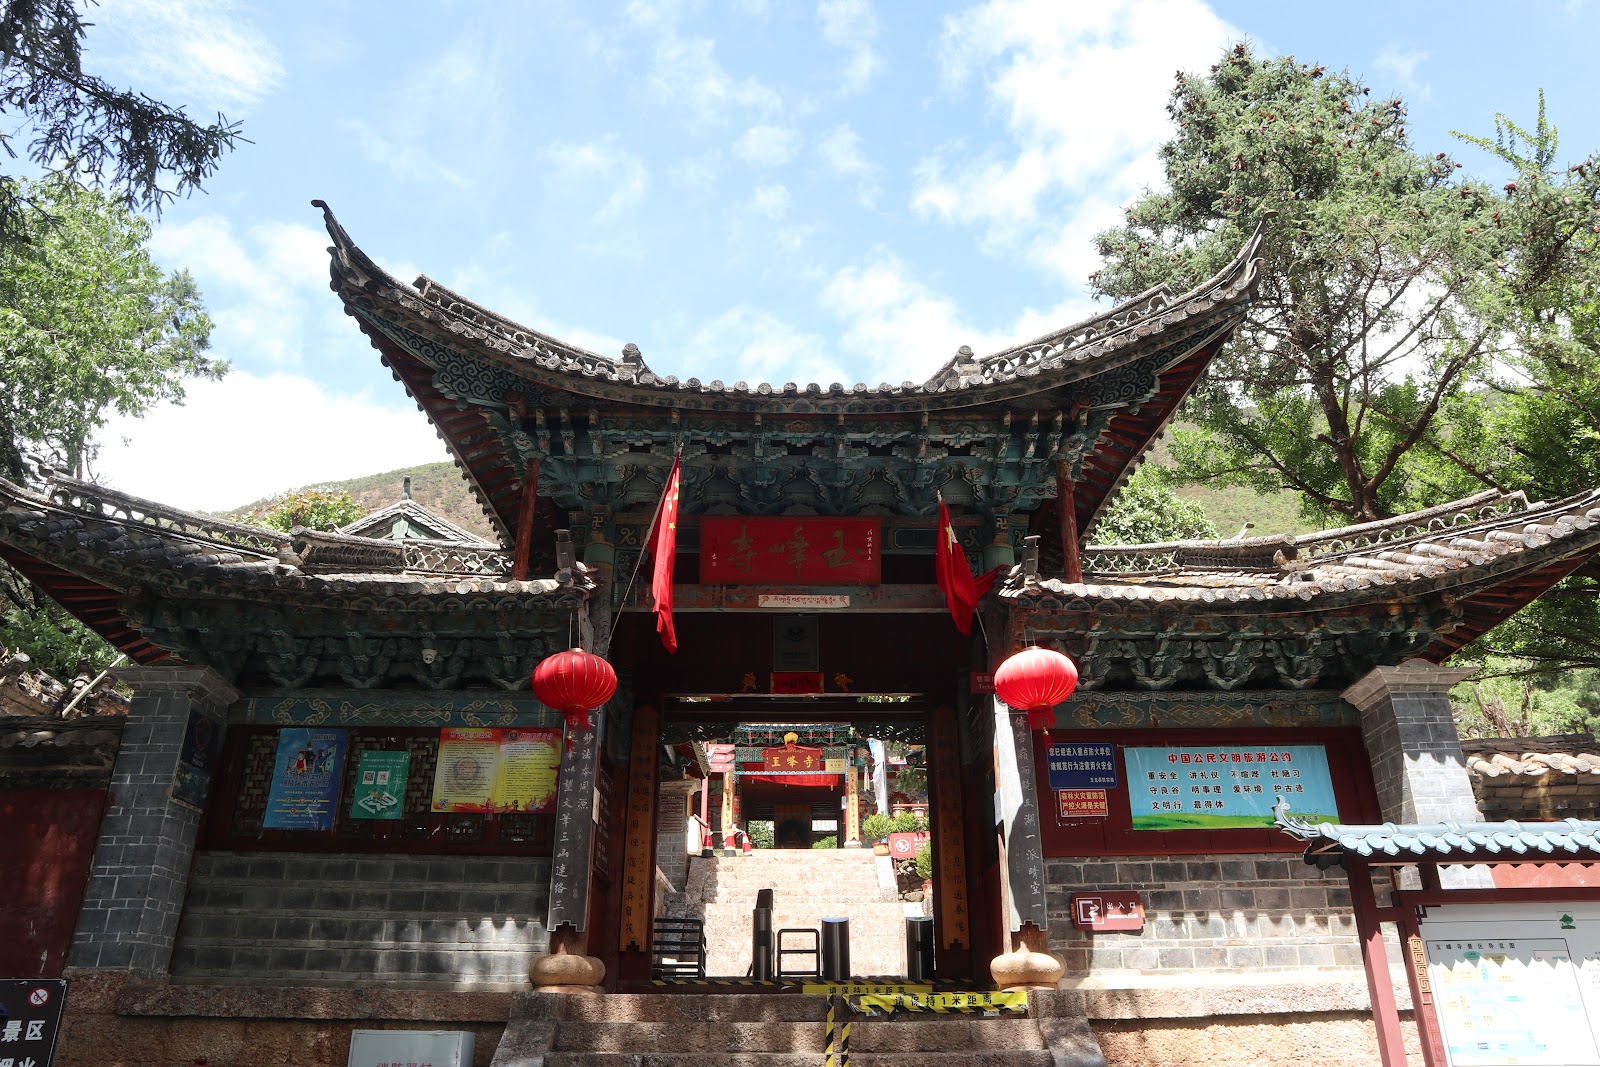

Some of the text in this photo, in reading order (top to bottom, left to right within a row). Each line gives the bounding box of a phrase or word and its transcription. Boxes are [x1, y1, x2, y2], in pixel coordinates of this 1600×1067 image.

[1049, 747, 1111, 757] 您已经进入重点防火单位
[1167, 752, 1292, 764] 中国公民文明旅游公约
[1050, 761, 1112, 771] 请规范行为注意用火安全
[1148, 769, 1301, 780] 重安全 讲礼仪 不喧哗 杜陋习
[1191, 785, 1222, 794] 明事理
[1232, 784, 1263, 794] 爱环境
[1273, 784, 1304, 793] 护古迹
[1061, 791, 1104, 800] 森林火灾重防范
[1062, 802, 1106, 810] 严控火源是关键
[1152, 801, 1182, 810] 文明行
[1107, 902, 1136, 910] 出入口
[829, 986, 906, 994] 请保持1米距离
[895, 994, 992, 1007] 请保持1米距离
[1, 1020, 46, 1042] 景区
